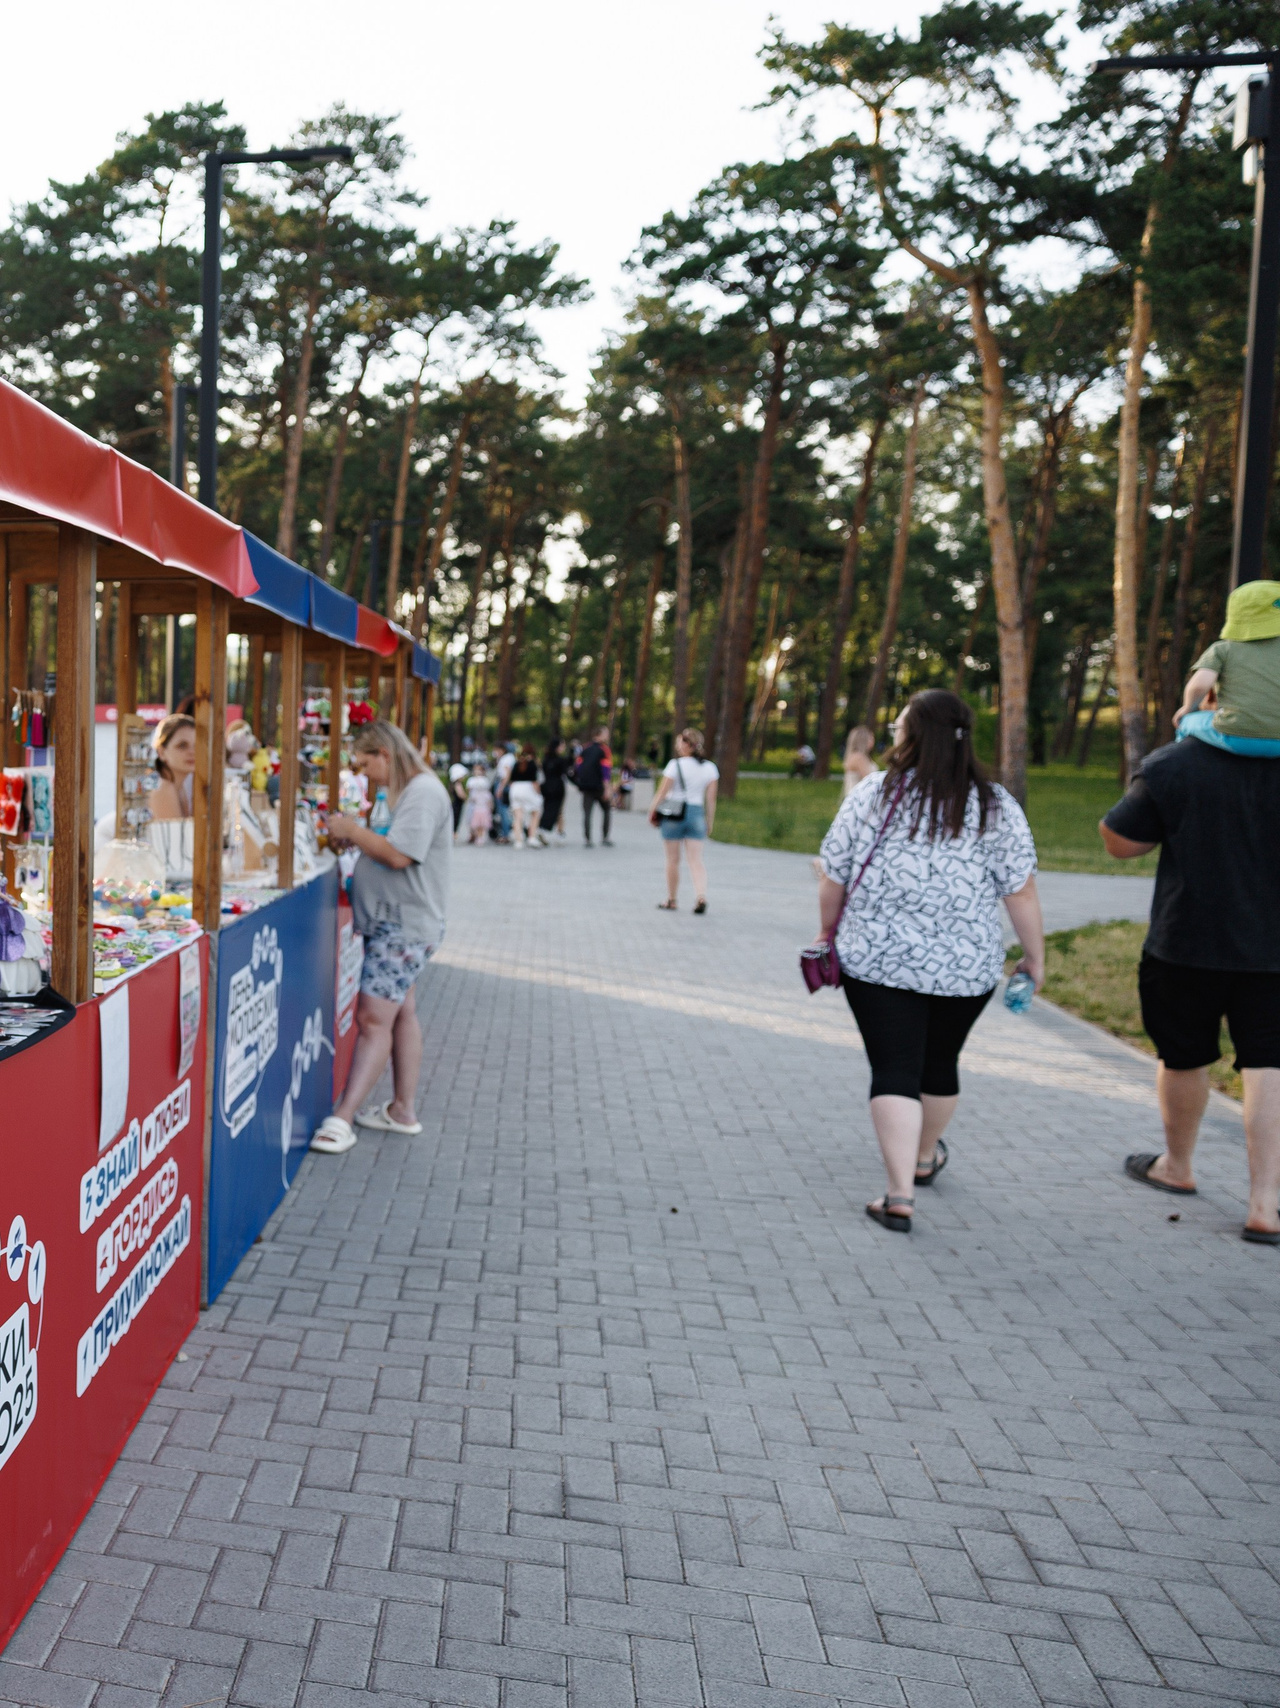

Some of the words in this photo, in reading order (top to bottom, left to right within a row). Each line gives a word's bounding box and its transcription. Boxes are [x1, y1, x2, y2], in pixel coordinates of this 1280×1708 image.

[95, 1124, 139, 1210] ЗНАЙ
[153, 1085, 190, 1148] ЛЮБИ
[110, 1164, 177, 1260] ГОРДИСЬ
[92, 1207, 191, 1366] ПРИУМНОЖАЙ
